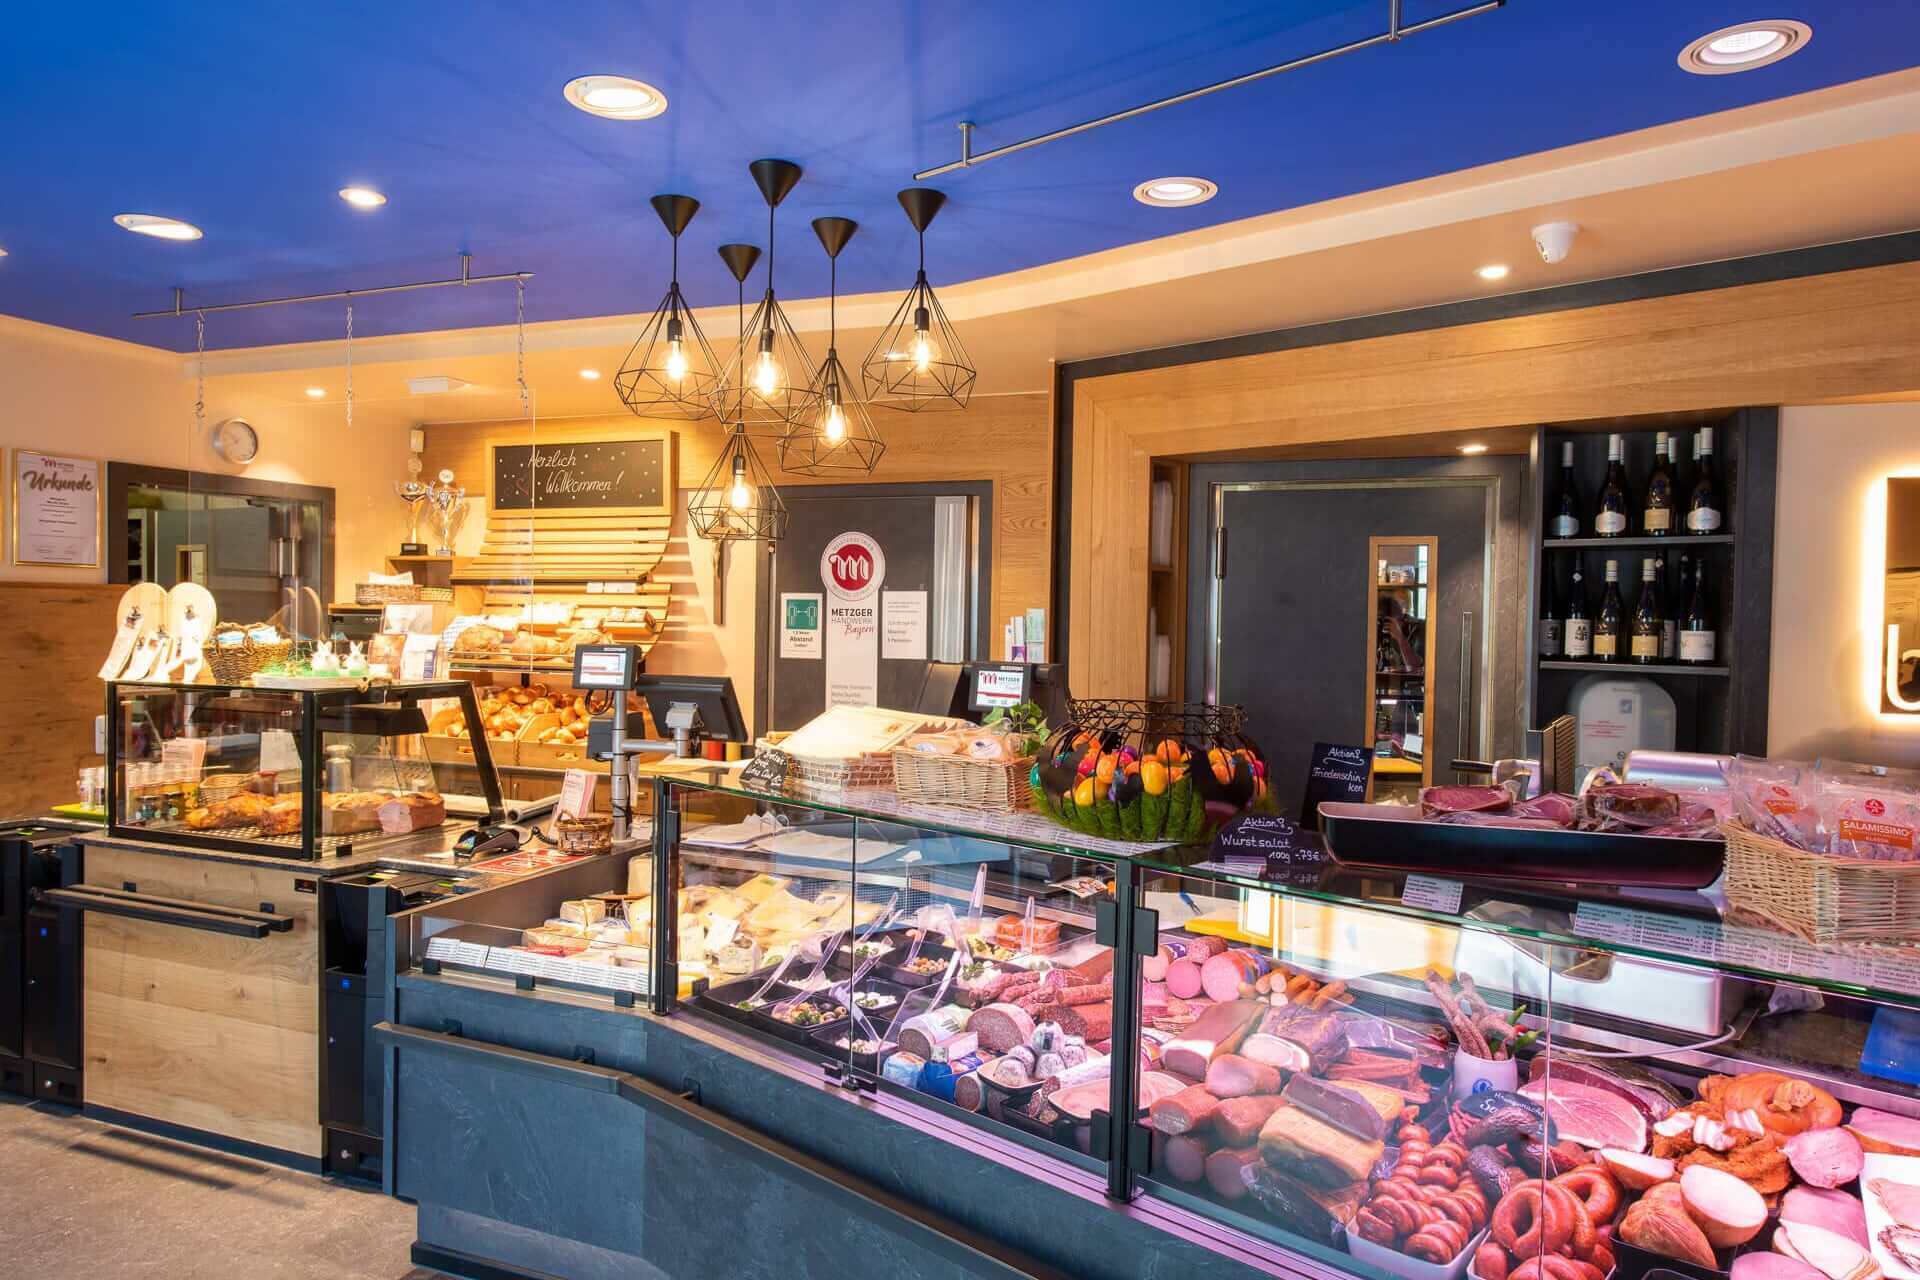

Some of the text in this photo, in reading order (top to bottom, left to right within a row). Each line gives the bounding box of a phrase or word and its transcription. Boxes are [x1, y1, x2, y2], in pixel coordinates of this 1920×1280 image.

[528, 448, 577, 468] Herzlich
[23, 470, 95, 492] Urkunde
[831, 608, 873, 617] METZGER
[831, 617, 873, 625] HANDWERK
[845, 624, 874, 640] Bayern
[1348, 783, 1364, 793] ken
[1843, 820, 1909, 838] SALAMISSIMO
[1220, 834, 1292, 849] Wurstsalat
[1268, 851, 1291, 865] 100g
